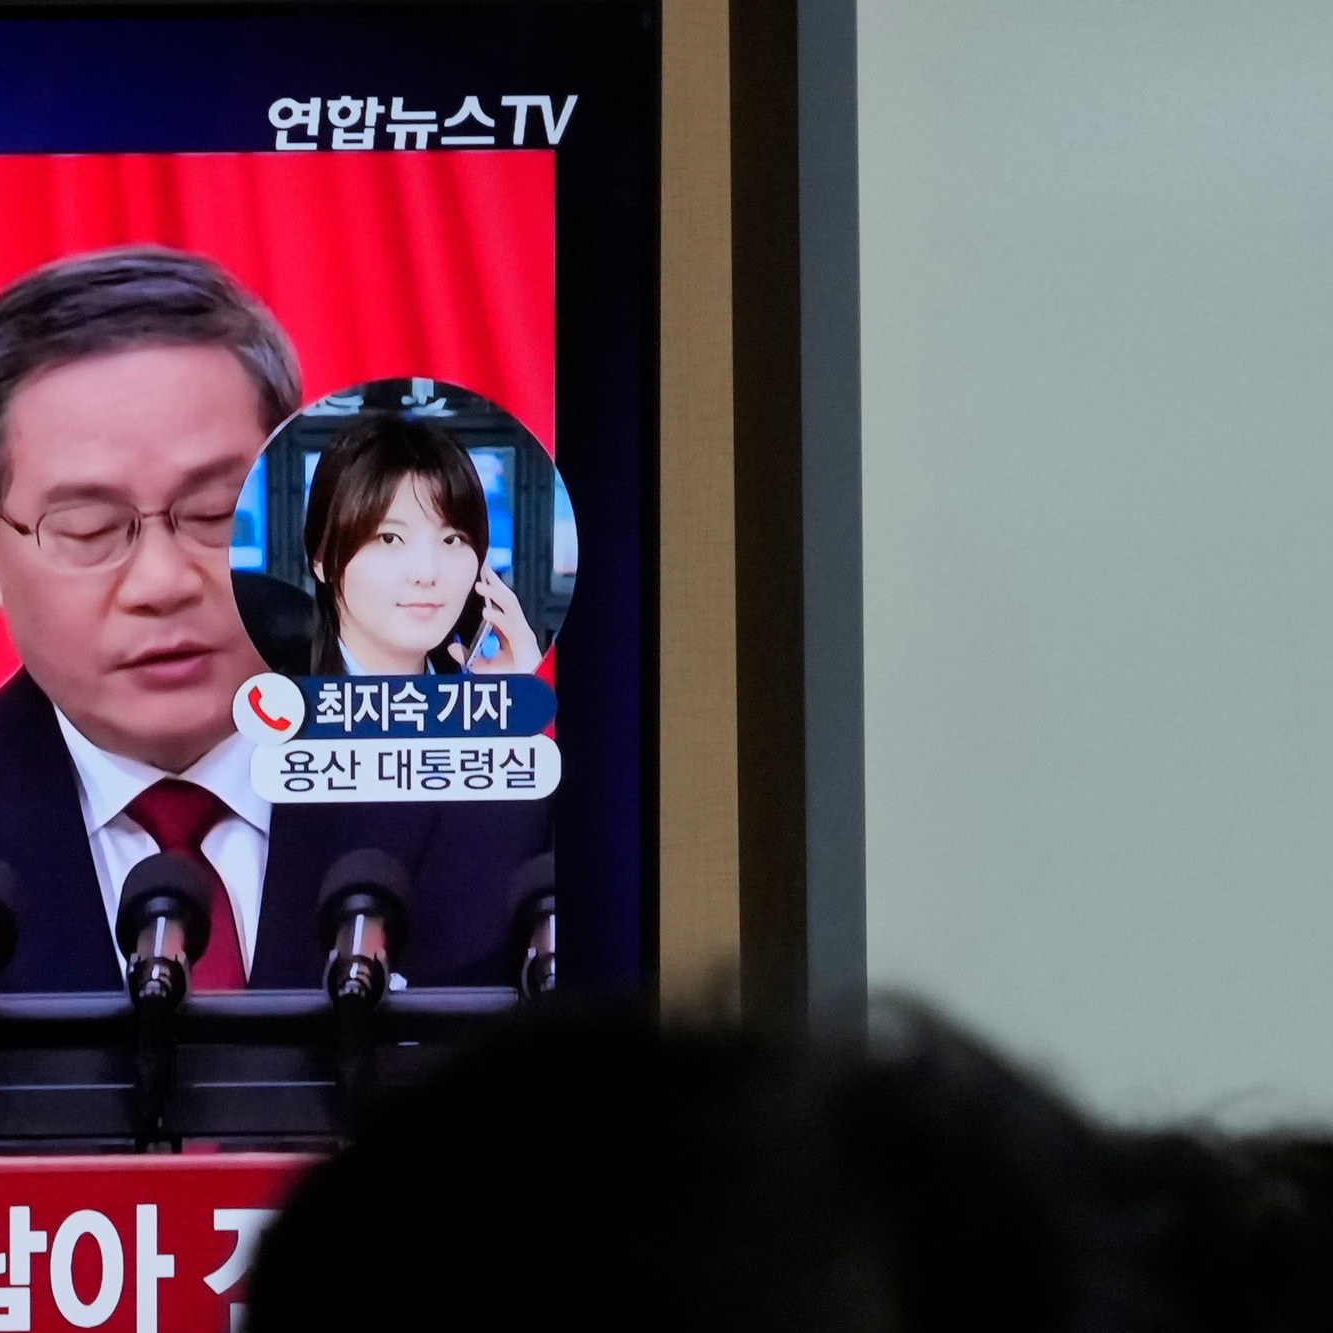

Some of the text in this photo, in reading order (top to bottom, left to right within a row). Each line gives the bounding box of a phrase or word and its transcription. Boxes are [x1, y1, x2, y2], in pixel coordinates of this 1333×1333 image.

[268, 94, 579, 151] 연합뉴스TV
[315, 679, 513, 733] 최지숙 기자
[278, 746, 538, 793] 용산 대통령실
